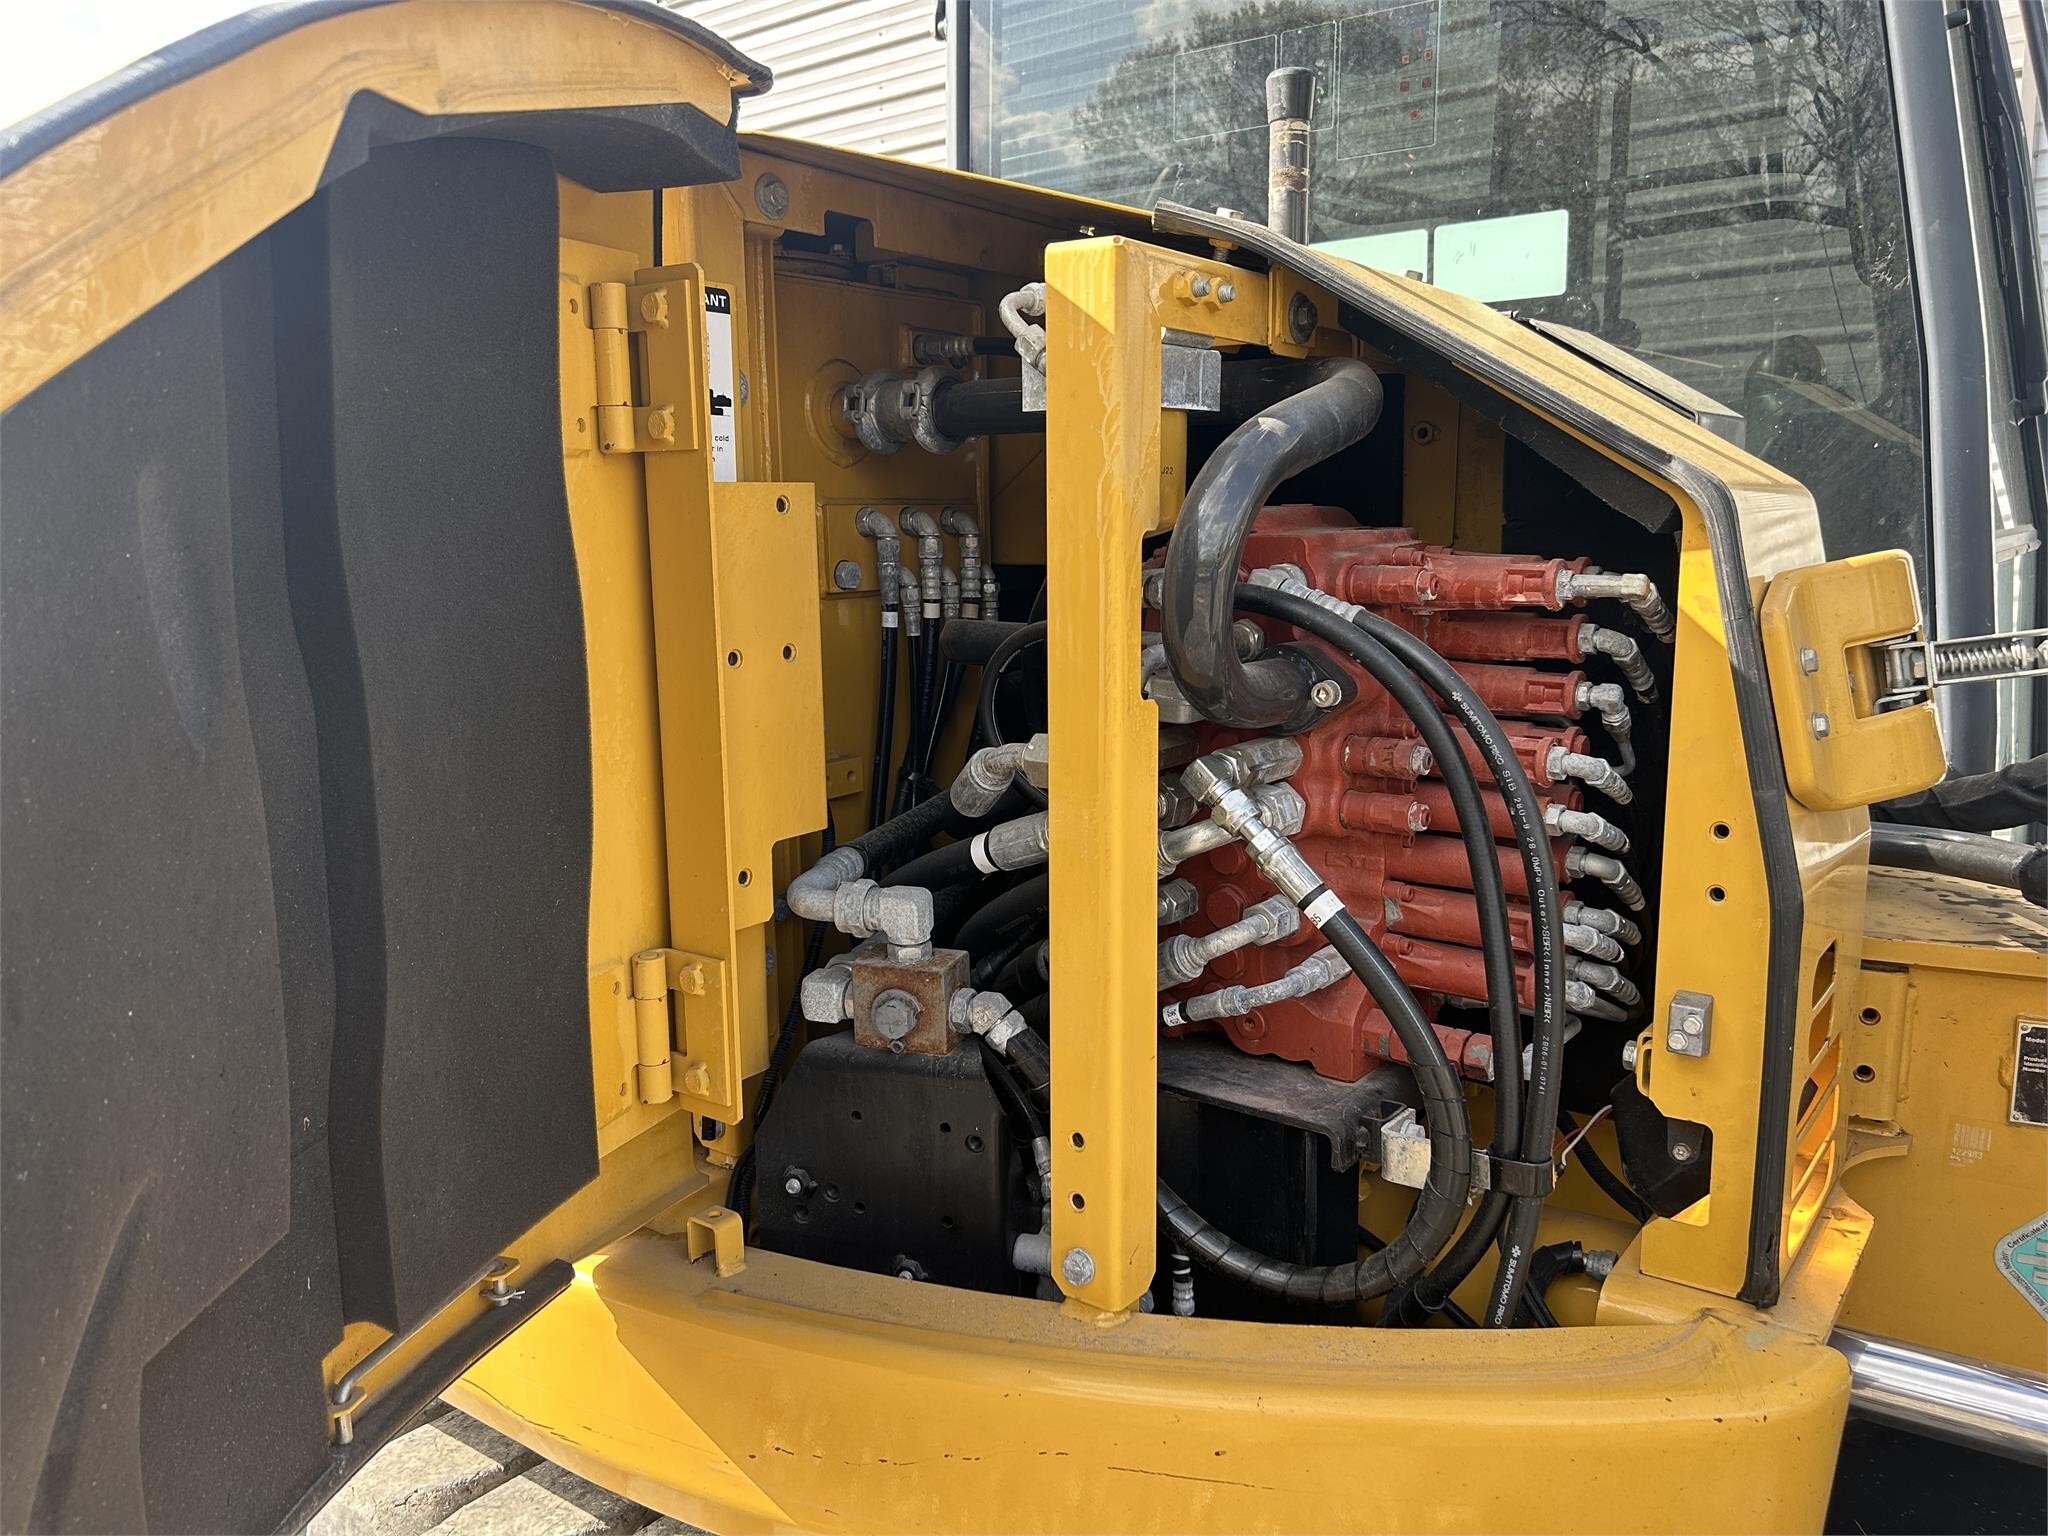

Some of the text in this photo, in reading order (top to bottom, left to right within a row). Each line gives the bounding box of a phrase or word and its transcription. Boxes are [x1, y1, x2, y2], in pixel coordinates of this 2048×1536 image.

[714, 434, 730, 443] cold
[1460, 702, 1493, 745] SUMITOMO
[1488, 744, 1505, 766] RIKO
[1525, 836, 1543, 882] 28.0MPa
[2025, 1036, 2046, 1044] Model
[2023, 1055, 2047, 1063] Product
[2022, 1066, 2046, 1074] Number
[2007, 1220, 2048, 1249] Certificate of
[1494, 1258, 1517, 1325] SUMITOMO RIKO
